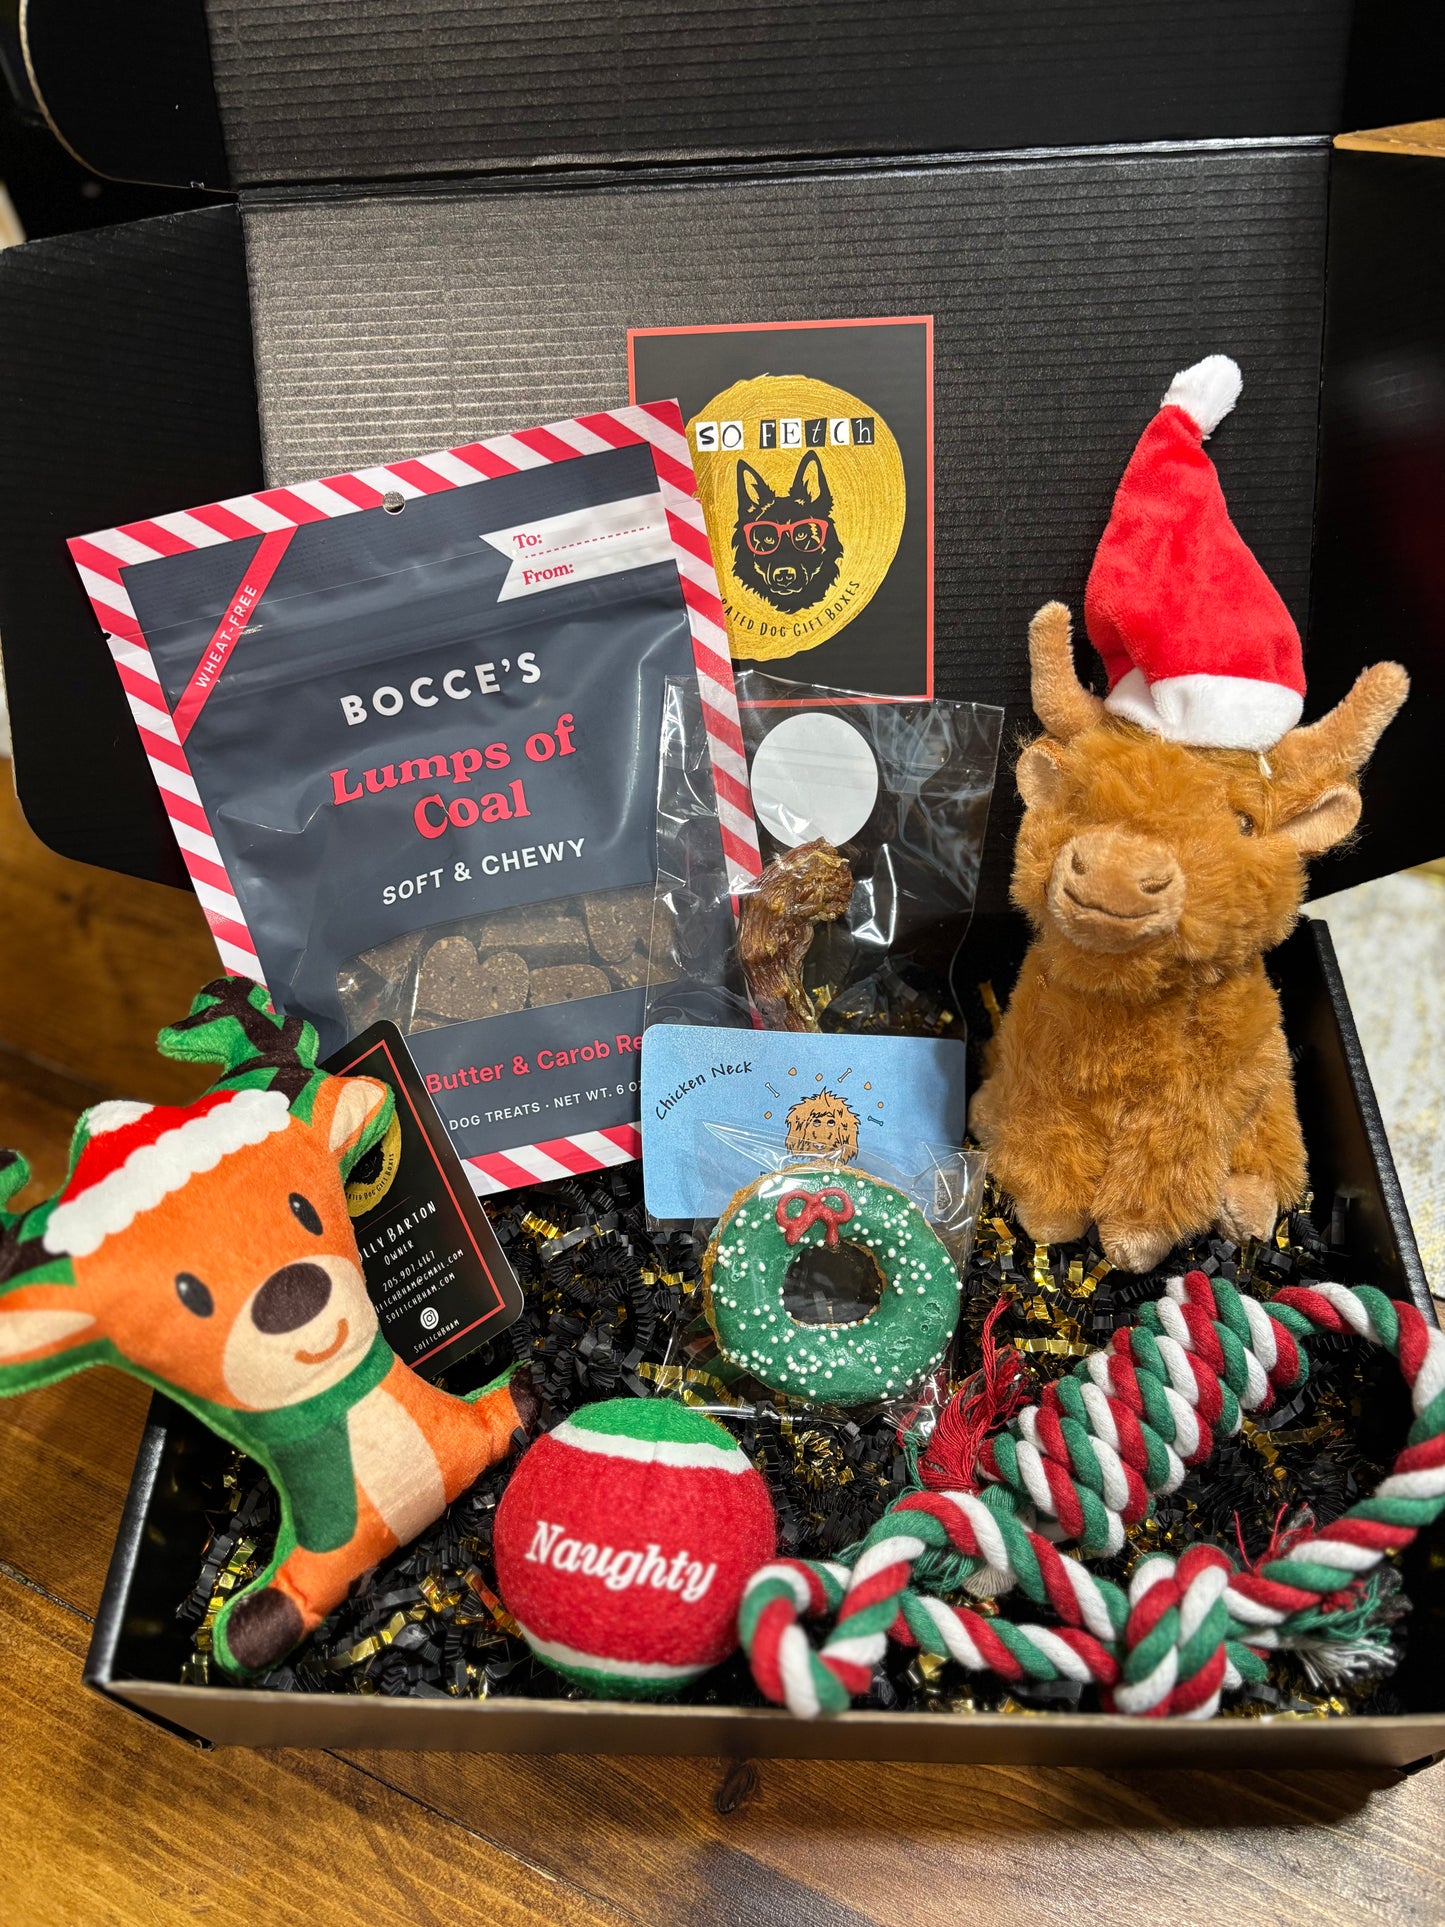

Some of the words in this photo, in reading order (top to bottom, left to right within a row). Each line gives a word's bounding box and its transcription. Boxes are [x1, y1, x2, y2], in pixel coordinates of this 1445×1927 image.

[697, 422, 743, 449] SO
[512, 533, 543, 550] To:
[521, 563, 574, 585] From:
[195, 584, 258, 688] WHEAT-FREE
[759, 622, 786, 637] DOG
[793, 615, 823, 637] GIFT
[824, 580, 860, 621] BOXES
[340, 652, 541, 726] BOCCE'S
[329, 742, 511, 806] Lumps
[524, 713, 577, 762] of
[413, 779, 531, 839] Coal
[382, 868, 443, 905] SOFT
[453, 861, 472, 882] &
[481, 838, 585, 876] CHEWY
[425, 1062, 504, 1095] Butter
[512, 1055, 530, 1076] &
[537, 1039, 610, 1071] Carob
[655, 1074, 706, 1120] Chicken
[711, 1060, 752, 1078] Neck
[449, 1114, 480, 1131] DOG
[485, 1102, 541, 1123] TREATS
[554, 1093, 581, 1109] NET
[585, 1087, 612, 1101] WT.
[616, 1084, 625, 1095] 6
[386, 1200, 436, 1243] BARTON
[524, 1520, 717, 1603] Naughty
